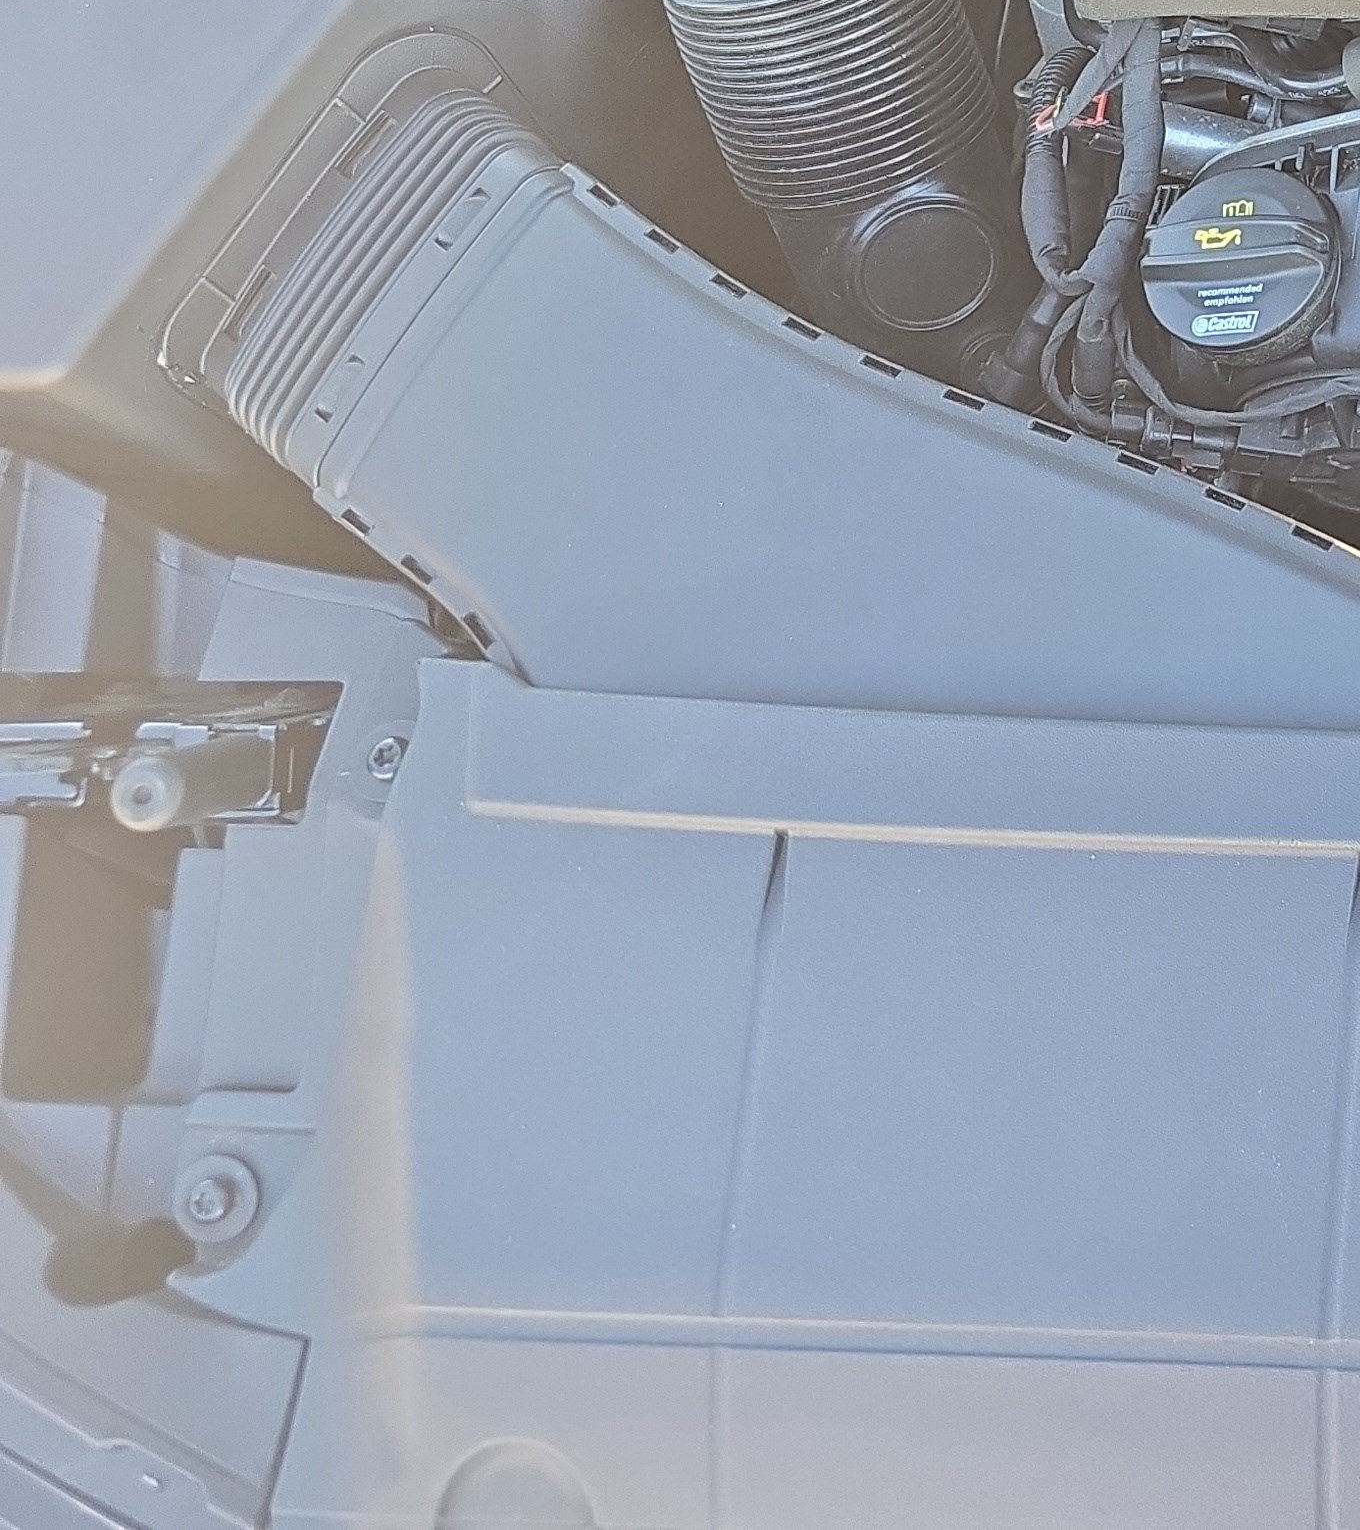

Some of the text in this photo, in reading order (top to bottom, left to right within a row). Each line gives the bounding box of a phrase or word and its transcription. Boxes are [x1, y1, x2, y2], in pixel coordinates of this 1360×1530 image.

[1197, 282, 1264, 298] recommended
[1203, 294, 1254, 307] empfohlen
[1208, 315, 1253, 331] Castrol
